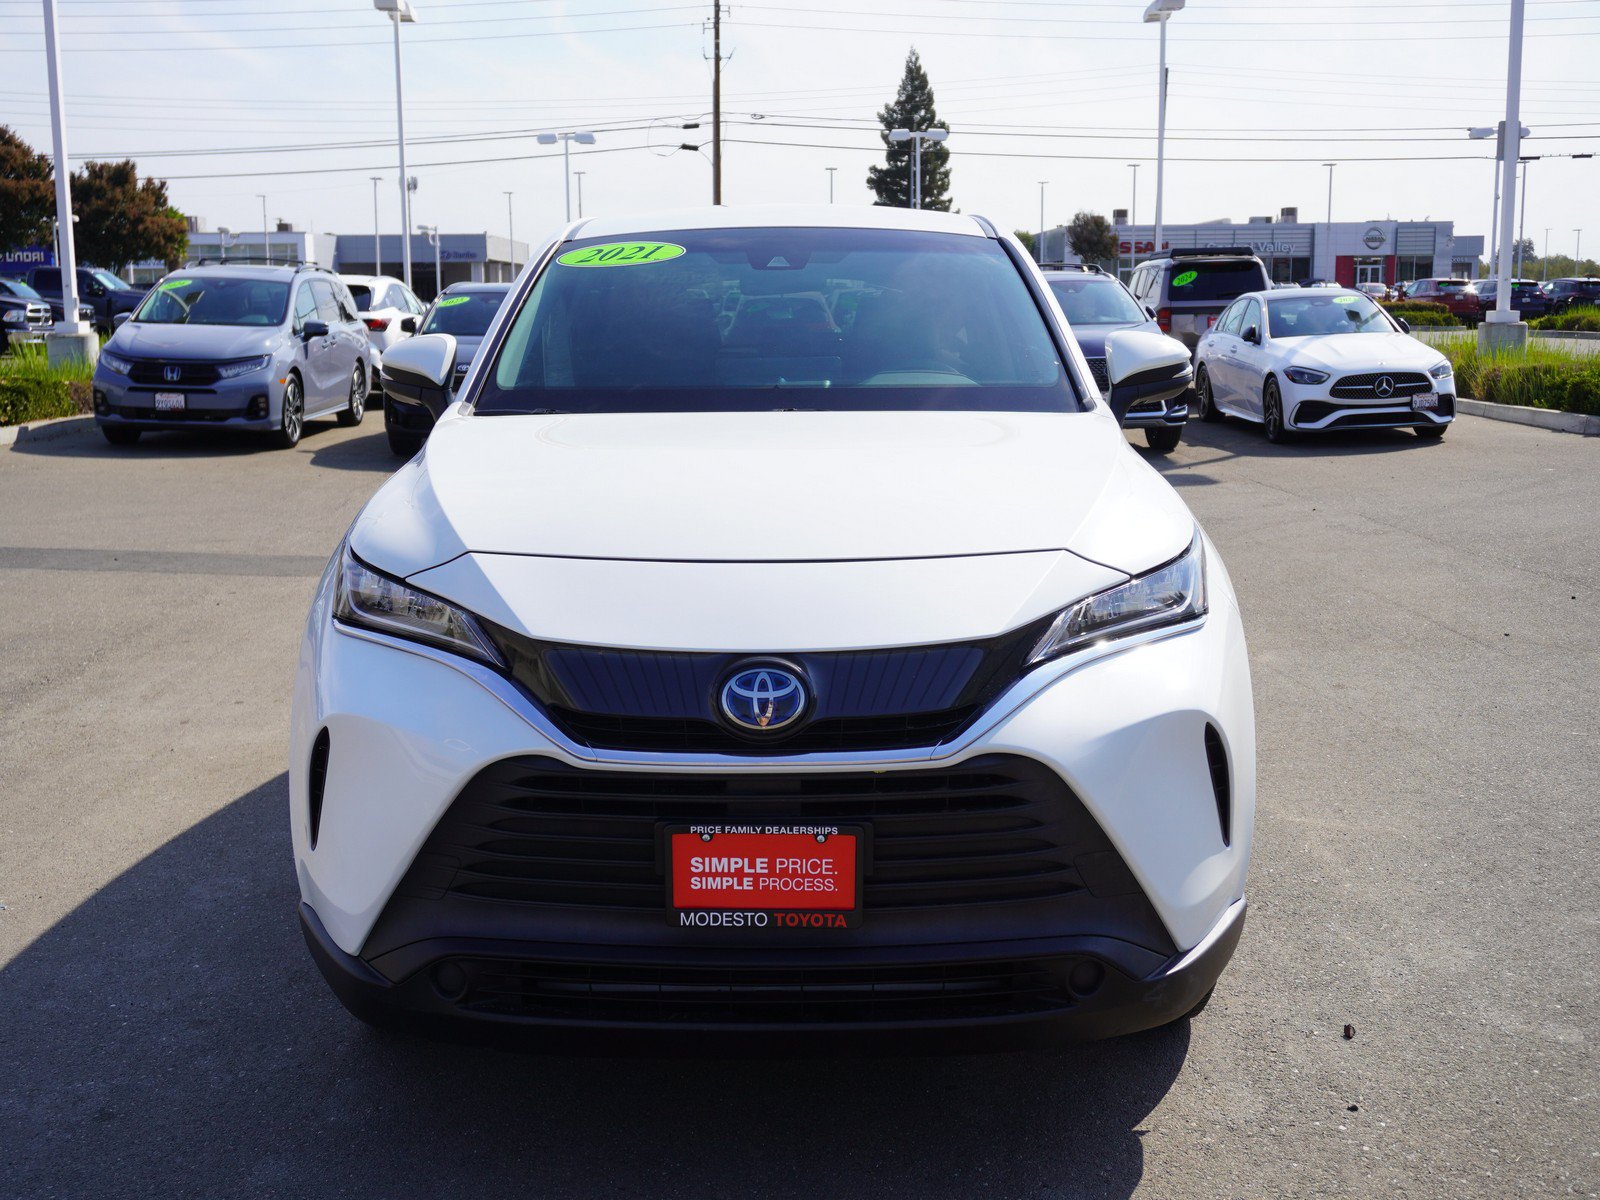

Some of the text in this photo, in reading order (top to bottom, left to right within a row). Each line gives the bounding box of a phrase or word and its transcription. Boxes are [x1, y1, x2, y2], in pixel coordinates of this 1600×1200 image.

[574, 245, 664, 264] 2021
[1257, 241, 1296, 254] Valley
[690, 826, 838, 835] PRICE FAMILY DEALERSHIPS
[690, 857, 838, 875] SIMPLE PRICE.
[690, 877, 838, 892] SIMPLE PROCESS.
[680, 912, 847, 928] MODESTO TOYOTA
